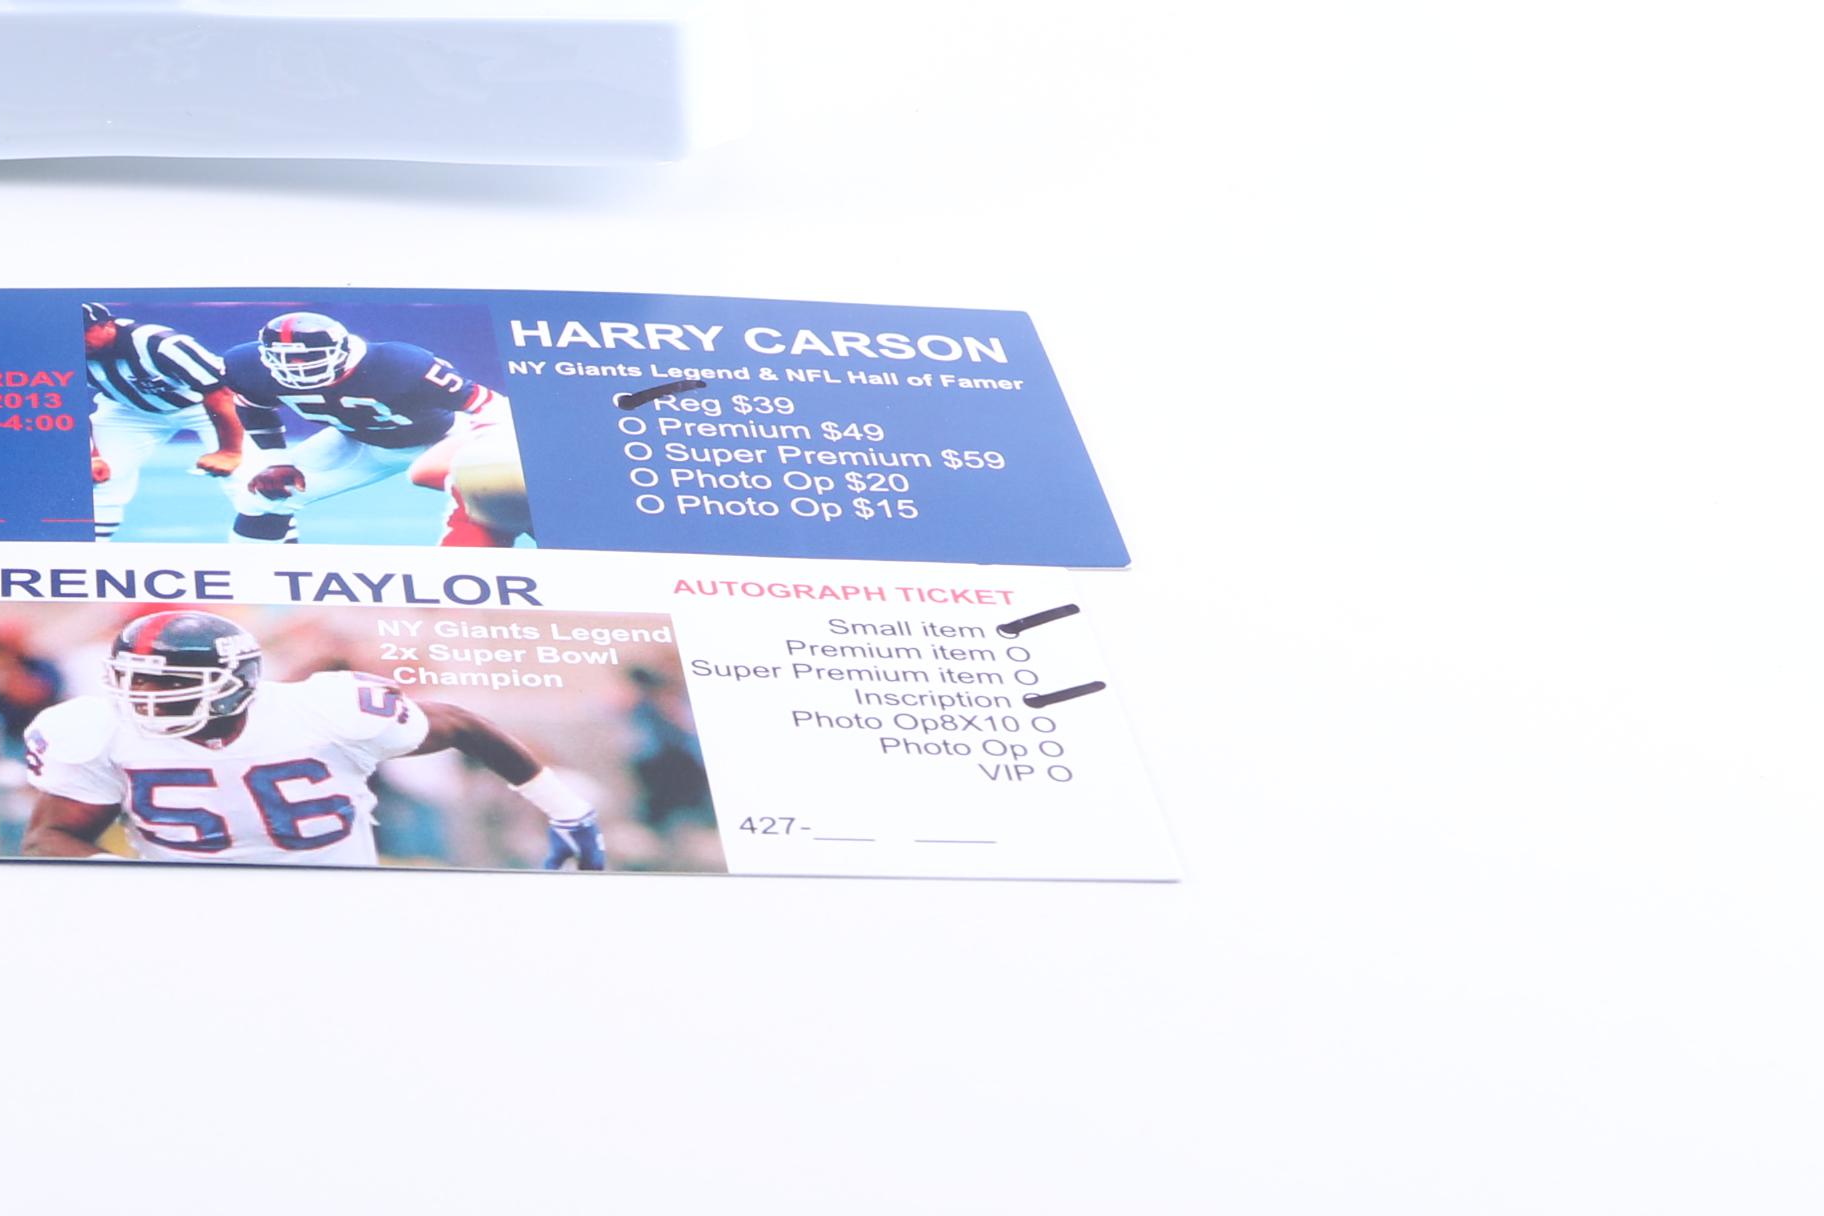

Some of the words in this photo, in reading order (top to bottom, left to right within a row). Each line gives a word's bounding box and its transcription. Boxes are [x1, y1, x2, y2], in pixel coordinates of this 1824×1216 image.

[510, 319, 724, 352] HARRY
[743, 326, 1009, 364] CARSON
[508, 360, 547, 375] NY
[554, 361, 643, 377] Giants
[650, 363, 751, 383] Legend
[758, 367, 780, 382] &
[785, 368, 842, 384] NFL
[846, 370, 899, 386] Hall
[906, 373, 933, 387] of
[939, 374, 1024, 391] Famer
[276, 394, 414, 432] 53
[653, 393, 722, 417] Reg
[731, 394, 795, 416] $39
[658, 417, 812, 440] Premium
[820, 420, 885, 443] $49
[664, 442, 769, 469] Super
[777, 445, 932, 468] Premium
[940, 448, 1006, 471] $59
[670, 468, 773, 490] Photo
[783, 470, 835, 496] Op
[844, 470, 910, 494] $20
[676, 494, 780, 517] Photo
[790, 496, 843, 522] Op
[852, 496, 919, 521] $15
[273, 570, 544, 607] TAYLOR
[673, 579, 887, 602] AUTOGRAPH
[894, 586, 1015, 606] TICKET
[376, 619, 424, 638] NY
[432, 620, 541, 640] Giants
[544, 623, 674, 650] Legend
[828, 618, 913, 637] Small
[920, 621, 986, 639] item
[377, 641, 423, 667] 2x
[427, 643, 527, 672] Super
[535, 645, 623, 668] Bowl
[785, 639, 922, 660] Premium
[932, 645, 996, 662] item
[390, 664, 564, 693] Champion
[690, 659, 782, 682] Super
[791, 662, 930, 683] Premium
[938, 667, 1004, 685] item
[854, 688, 1012, 712] Inscription
[791, 710, 883, 730] Photo
[892, 712, 1020, 735] Op8X10
[879, 736, 972, 756] Photo
[981, 738, 1029, 761] Op
[977, 763, 1035, 782] VIP
[124, 758, 358, 854] 56
